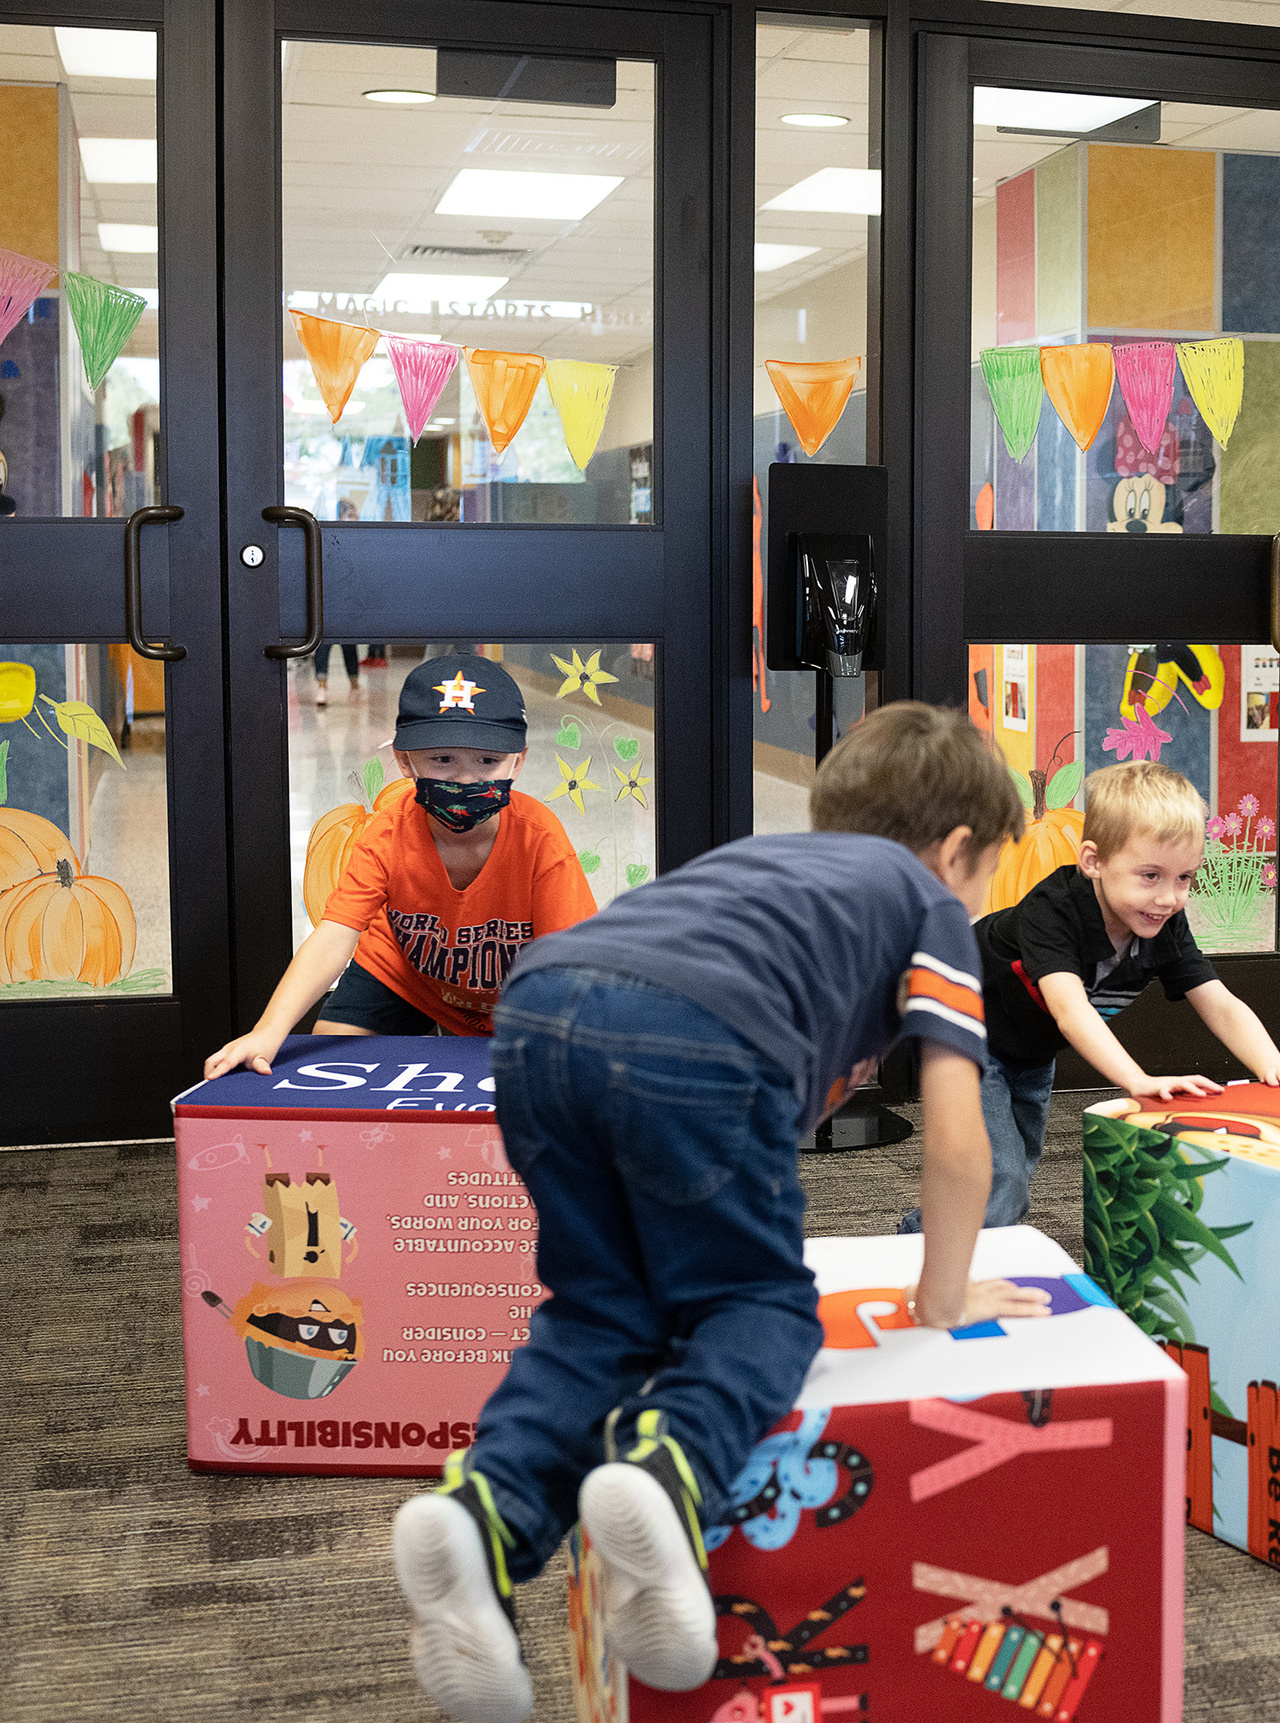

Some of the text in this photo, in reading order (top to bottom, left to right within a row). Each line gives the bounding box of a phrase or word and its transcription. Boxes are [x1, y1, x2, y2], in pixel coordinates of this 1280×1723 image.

[456, 918, 534, 946] SERIES
[272, 1062, 496, 1092] Sh
[423, 1194, 460, 1208] AND
[457, 1216, 504, 1231] YOUR
[393, 1238, 515, 1253] ACCOUNTABLE
[406, 1282, 543, 1297] CONSEQUENCES
[508, 1305, 535, 1319] HE
[402, 1326, 487, 1341] CONSIDER
[382, 1348, 418, 1363] YOU
[421, 1348, 488, 1363] BEFORE
